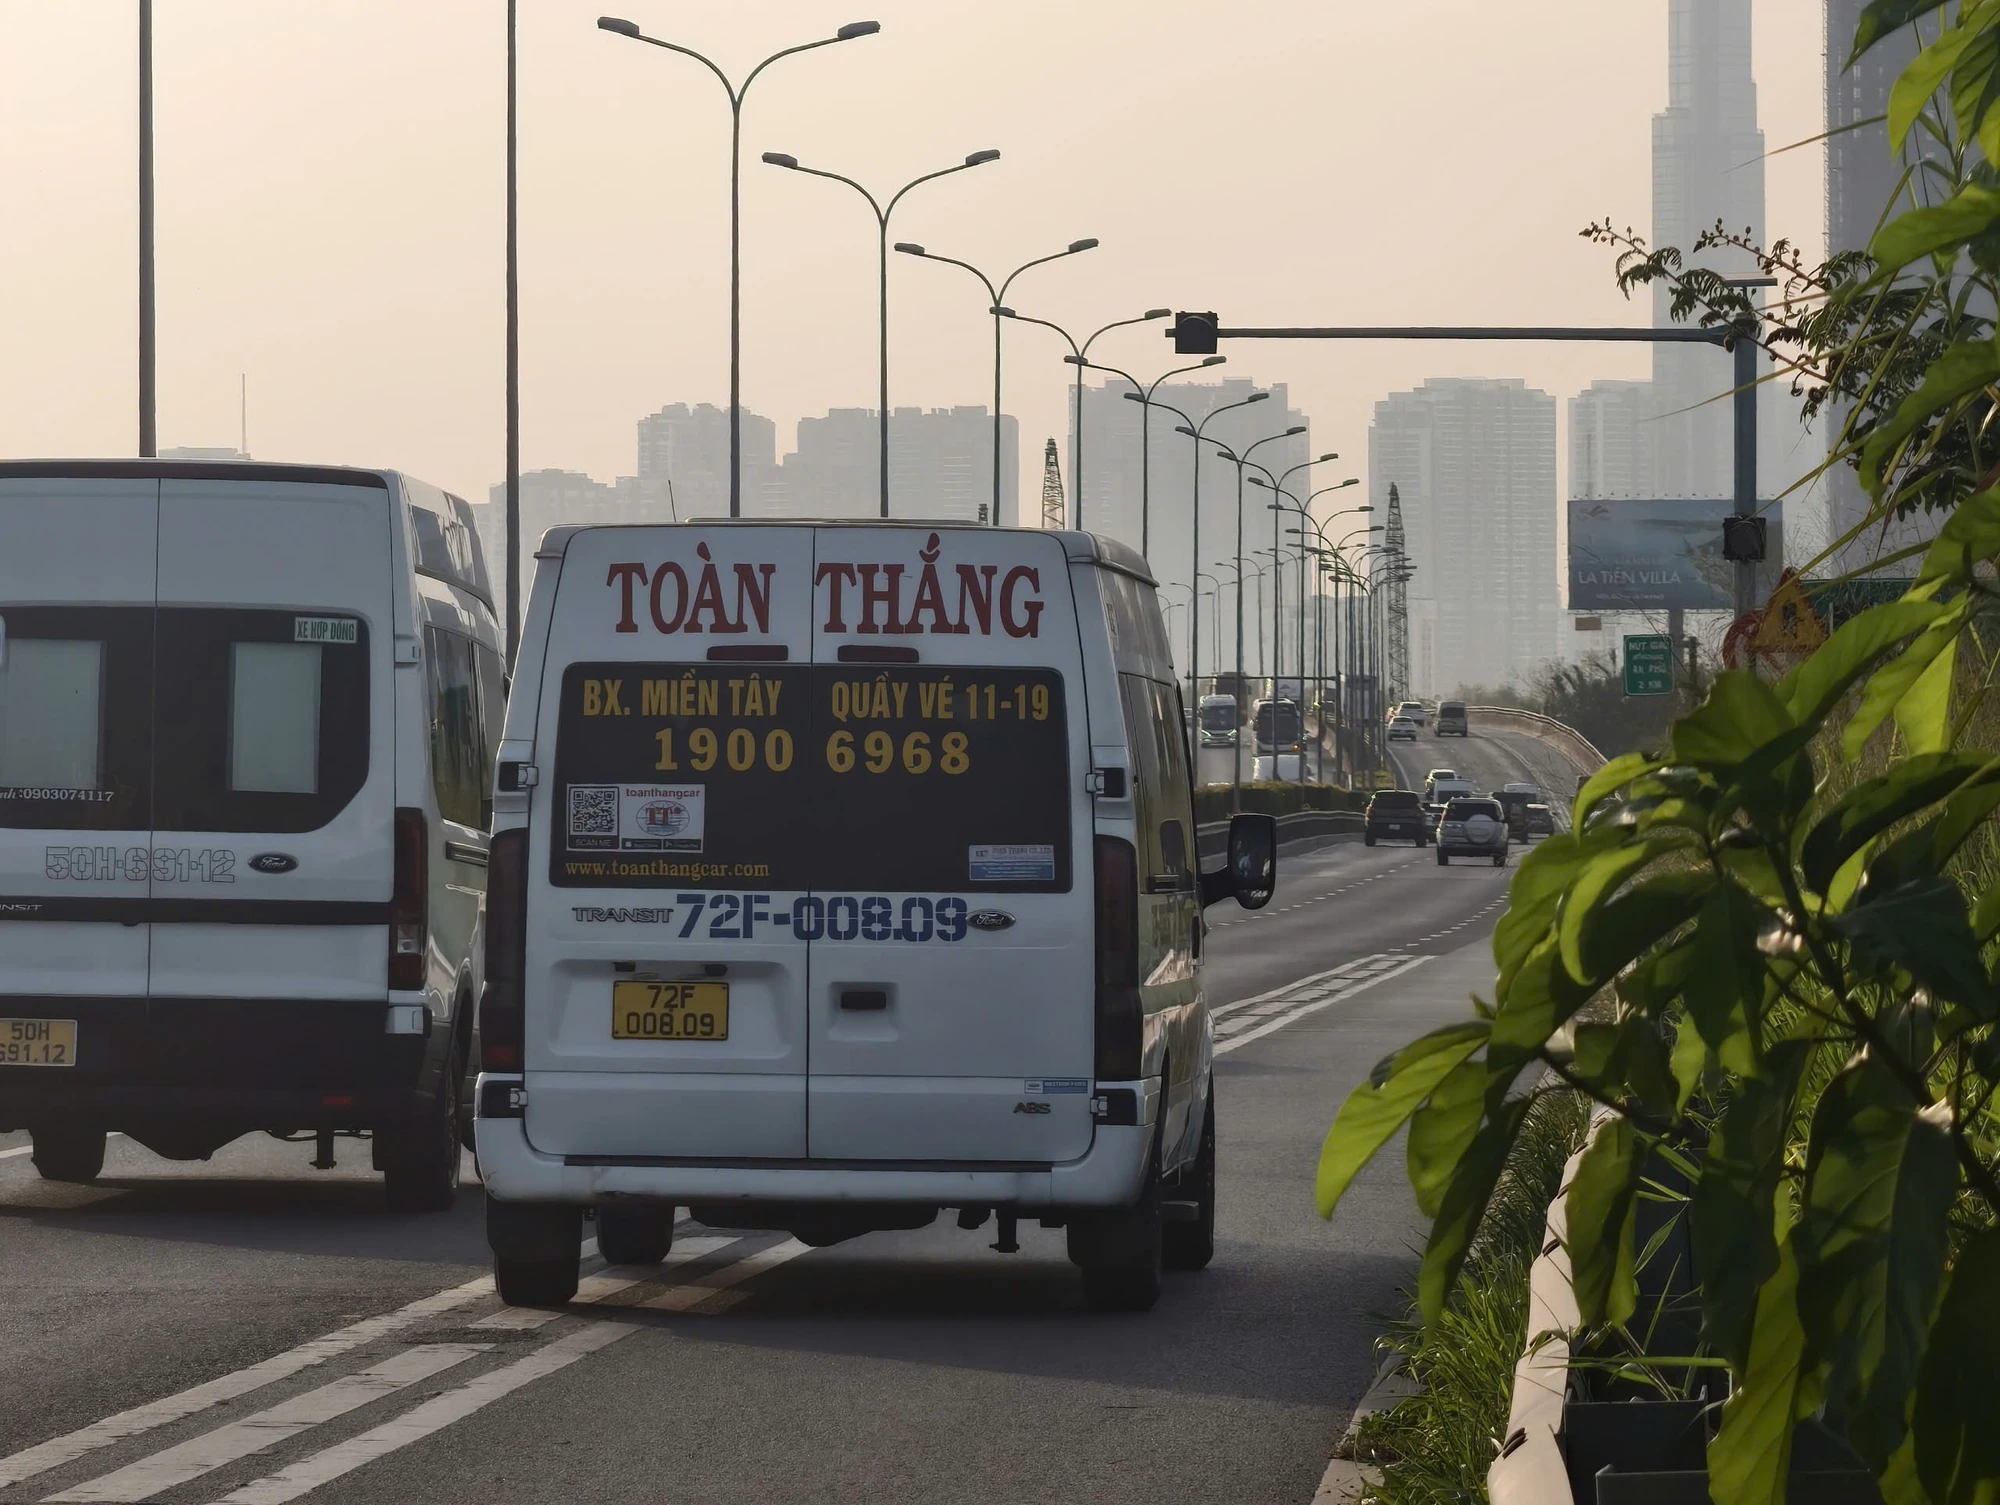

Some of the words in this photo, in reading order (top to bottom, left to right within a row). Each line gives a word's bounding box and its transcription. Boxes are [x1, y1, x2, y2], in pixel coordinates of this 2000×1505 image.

[606, 541, 776, 635] TOÀN
[814, 532, 1045, 638] THẮNG
[1578, 571, 1598, 584] LA
[1638, 571, 1681, 584] VILLA
[297, 620, 309, 639] XE
[583, 678, 631, 716] BX.
[642, 667, 719, 717] MIỀN
[729, 672, 782, 716] TÂY
[831, 670, 909, 722] QUẦY
[918, 674, 954, 720] VÉ
[966, 684, 1049, 720] 11-19
[655, 727, 794, 772] 1900
[826, 731, 970, 775] 6968
[626, 787, 700, 799] toanthangcar
[565, 859, 769, 880] www.toanthangcar.com
[572, 907, 674, 923] TRANSIT
[676, 894, 968, 942] 72F-008.09
[646, 985, 696, 1009] 72F
[11, 1021, 50, 1041] 50H
[626, 1012, 715, 1037] 008.09
[1013, 1102, 1051, 1115] ABS
